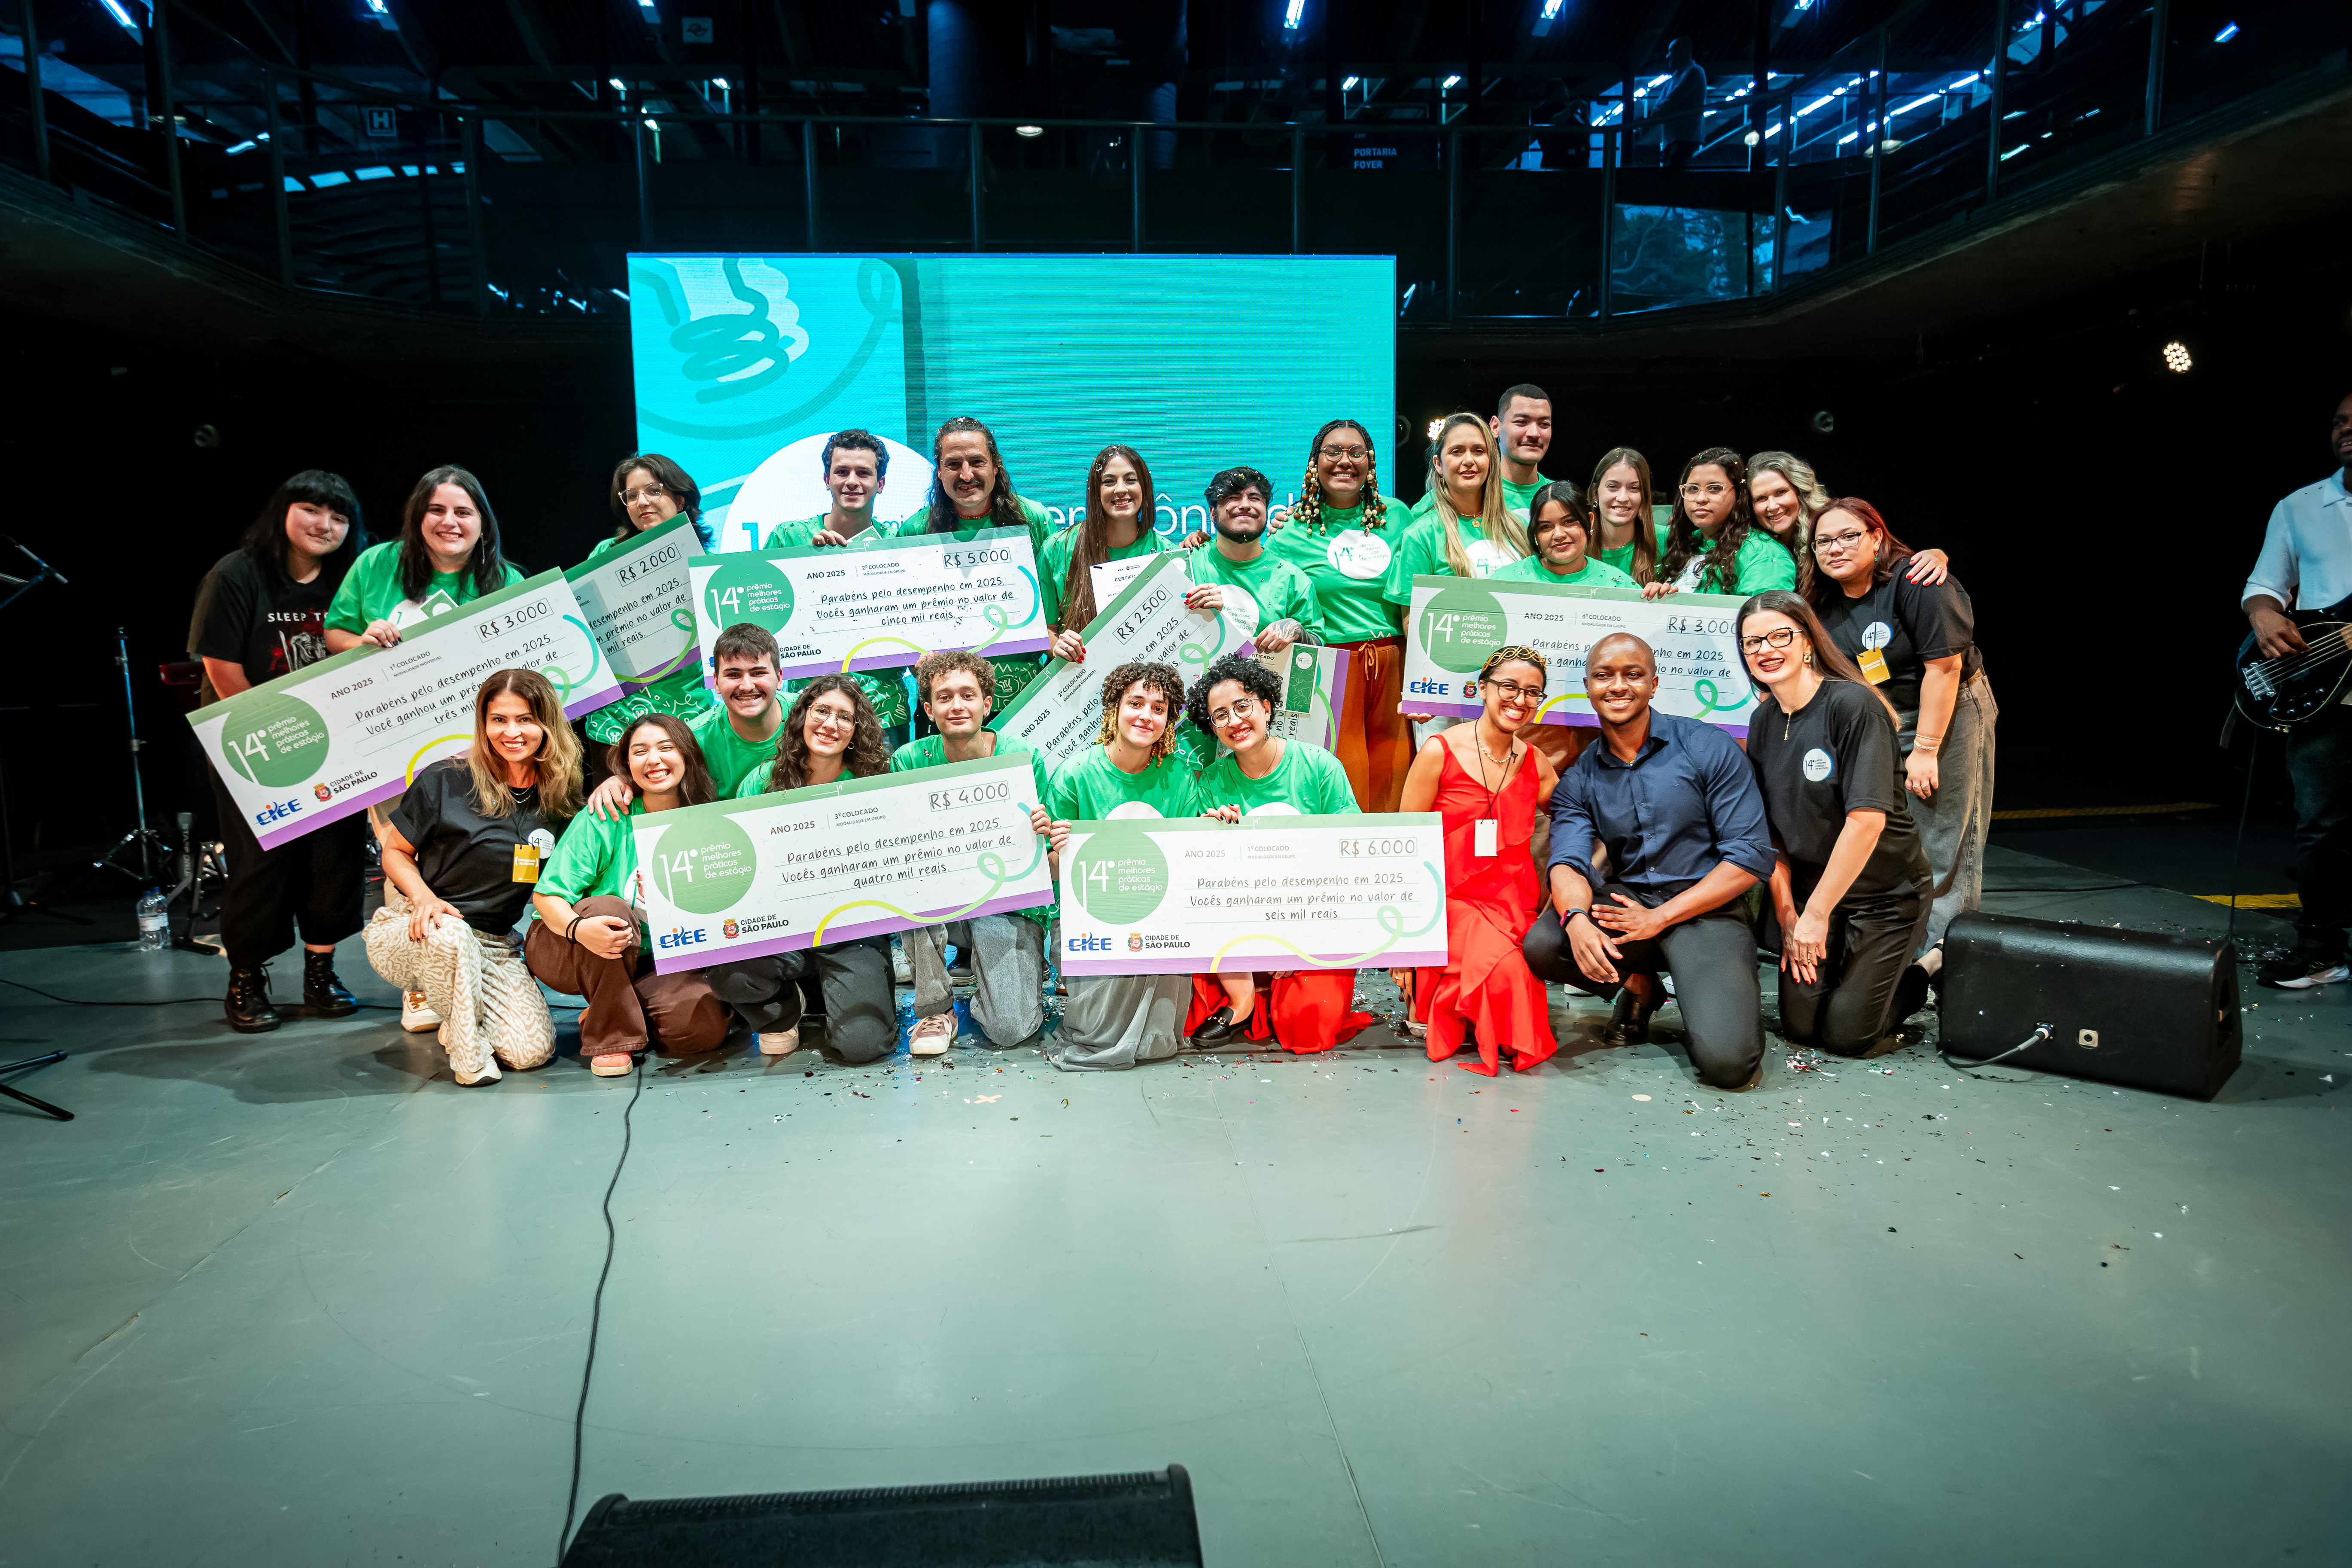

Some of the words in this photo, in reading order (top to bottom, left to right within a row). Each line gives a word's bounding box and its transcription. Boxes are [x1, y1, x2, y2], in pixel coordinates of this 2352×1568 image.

[1354, 147, 1397, 157] PORTARIA
[1354, 160, 1383, 169] FOYER
[619, 565, 637, 584] R$
[639, 546, 676, 574] 2.000
[943, 553, 961, 568] R$
[967, 549, 1009, 564] 5.000
[806, 571, 825, 580] ANO
[826, 569, 846, 578] 2025
[1114, 574, 1139, 582] CERTIFIC
[641, 593, 654, 603] em
[655, 577, 683, 597] 2025.
[746, 582, 773, 593] prêmio
[747, 589, 782, 598] melhores
[748, 596, 779, 607] práticas
[761, 602, 791, 612] estágio
[268, 612, 306, 623] SLEEP
[479, 621, 500, 639] R$
[504, 602, 548, 628] 3.000
[604, 620, 634, 642] prêmio
[636, 614, 648, 624] no
[649, 601, 671, 617] valor
[675, 594, 687, 605] de
[1117, 621, 1135, 640] R$
[1134, 590, 1167, 624] 2.500
[1524, 612, 1543, 620] ANO
[1544, 614, 1564, 622] 2025
[1668, 617, 1687, 633] R$
[606, 640, 620, 655] mil
[621, 630, 646, 647] reais.
[1145, 640, 1158, 652] em
[1156, 616, 1181, 641] 2025.
[1157, 641, 1177, 661] valor
[1178, 629, 1190, 642] de
[1532, 638, 1579, 651] Parabéns
[1677, 650, 1691, 659] em
[1695, 649, 1725, 661] 2025.
[396, 651, 431, 668] COLOCADO
[780, 651, 796, 659] SÃO
[797, 649, 822, 658] PAULO
[393, 664, 420, 678] MODALIDADE
[419, 655, 442, 667] INDIVIDUAL
[1688, 666, 1714, 676] valor
[1718, 668, 1731, 678] de
[355, 696, 408, 722] Parabéns
[410, 685, 433, 702] pelo
[437, 657, 501, 688] desempenho
[505, 649, 520, 660] em
[522, 633, 554, 653] 2025.
[1062, 668, 1086, 693] COLOCADO
[1063, 683, 1082, 702] MODALIDADE
[1080, 669, 1097, 685] INDIVIDUAL
[1409, 676, 1449, 696] CIEE
[331, 686, 351, 700] ANO
[351, 677, 374, 691] 2025
[365, 717, 393, 735] Você
[397, 702, 437, 726] ganhou
[439, 694, 456, 706] um
[518, 658, 541, 676] alor
[545, 651, 558, 662] de
[434, 709, 458, 724] três
[460, 699, 479, 714] mil
[1021, 723, 1036, 738] ANO
[1034, 709, 1050, 726] 2025
[1045, 715, 1082, 751] Parabéns
[1081, 698, 1099, 718] pelo
[1057, 738, 1078, 759] Você
[329, 774, 353, 787] CIDADE
[333, 783, 351, 794] SÃO
[350, 771, 378, 787] PAULO
[930, 791, 951, 810] R$
[958, 782, 1008, 804] 4.000
[256, 798, 303, 826] CIEE
[842, 807, 879, 818] COLOCADO
[770, 825, 791, 835] ANO
[792, 820, 815, 831] 2025
[836, 818, 864, 826] MODALIDADE
[700, 841, 731, 856] prêmio
[787, 846, 842, 865] Parabéns
[846, 841, 870, 857] pelo
[875, 829, 944, 849] desempenho
[949, 826, 965, 836] em
[969, 817, 1002, 833] 2025.
[1340, 839, 1360, 857] R$
[1368, 839, 1415, 856] 6.000
[702, 849, 742, 862] melhores
[782, 868, 815, 883] Vocês
[820, 859, 878, 879] ganharam
[882, 856, 899, 866] um
[904, 846, 943, 865] prêmio
[947, 845, 961, 854] no
[965, 838, 993, 852] valor
[998, 834, 1012, 846] de
[1184, 850, 1204, 858] ANO
[1205, 849, 1226, 858] 2025
[703, 859, 738, 873] práticas
[1117, 858, 1147, 868] prêmio
[1118, 866, 1156, 874] melhores
[705, 871, 718, 880] de
[718, 865, 752, 877] estágio
[853, 873, 892, 889] quatro
[897, 866, 914, 880] mil
[918, 864, 949, 876] reais.
[1118, 874, 1151, 885] práticas
[1131, 882, 1163, 894] estágio
[740, 916, 764, 926] CIDADE
[1265, 910, 1285, 921] seis
[1290, 909, 1306, 920] mil
[1311, 908, 1340, 919] reais.
[741, 924, 760, 934] SÃO
[761, 919, 789, 930] PAULO
[660, 926, 707, 949] CIEE
[1068, 932, 1112, 951] CIEE
